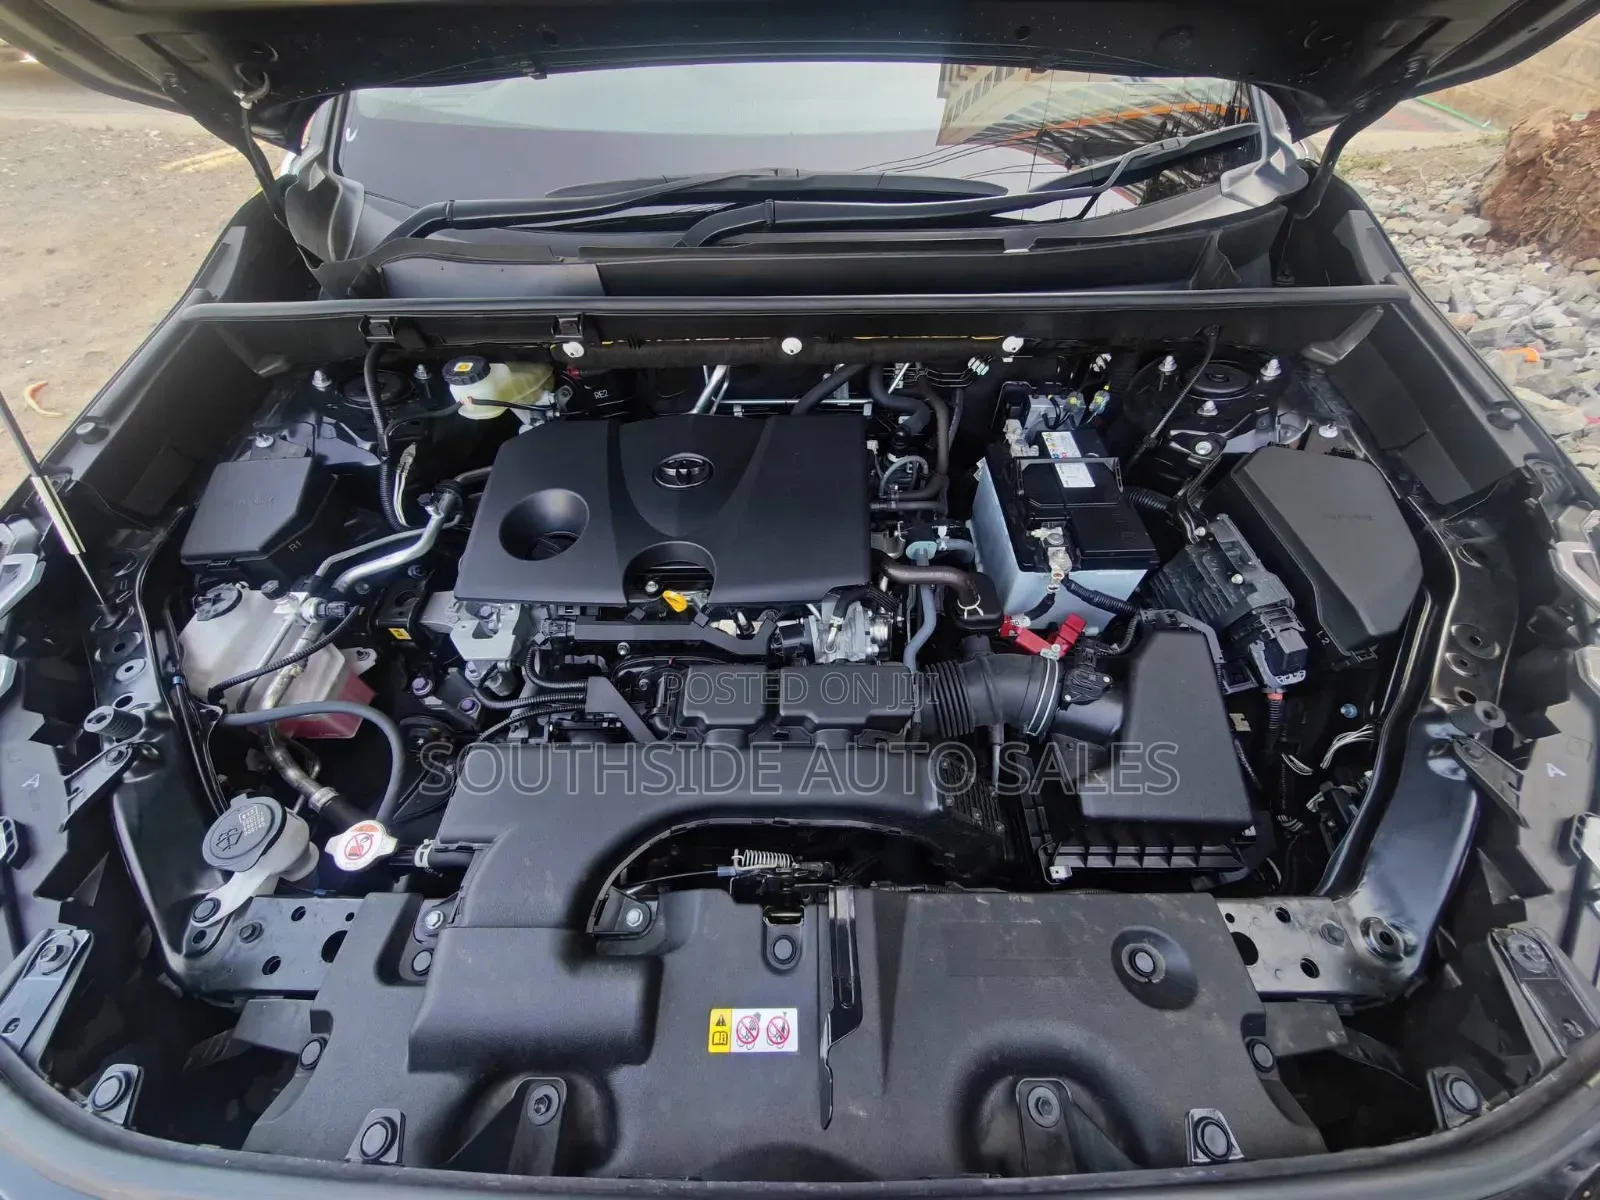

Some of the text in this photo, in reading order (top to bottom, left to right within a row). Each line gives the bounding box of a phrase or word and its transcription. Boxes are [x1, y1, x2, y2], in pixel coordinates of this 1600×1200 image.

[288, 540, 303, 552] R1
[1545, 762, 1567, 778] A
[21, 773, 40, 788] A
